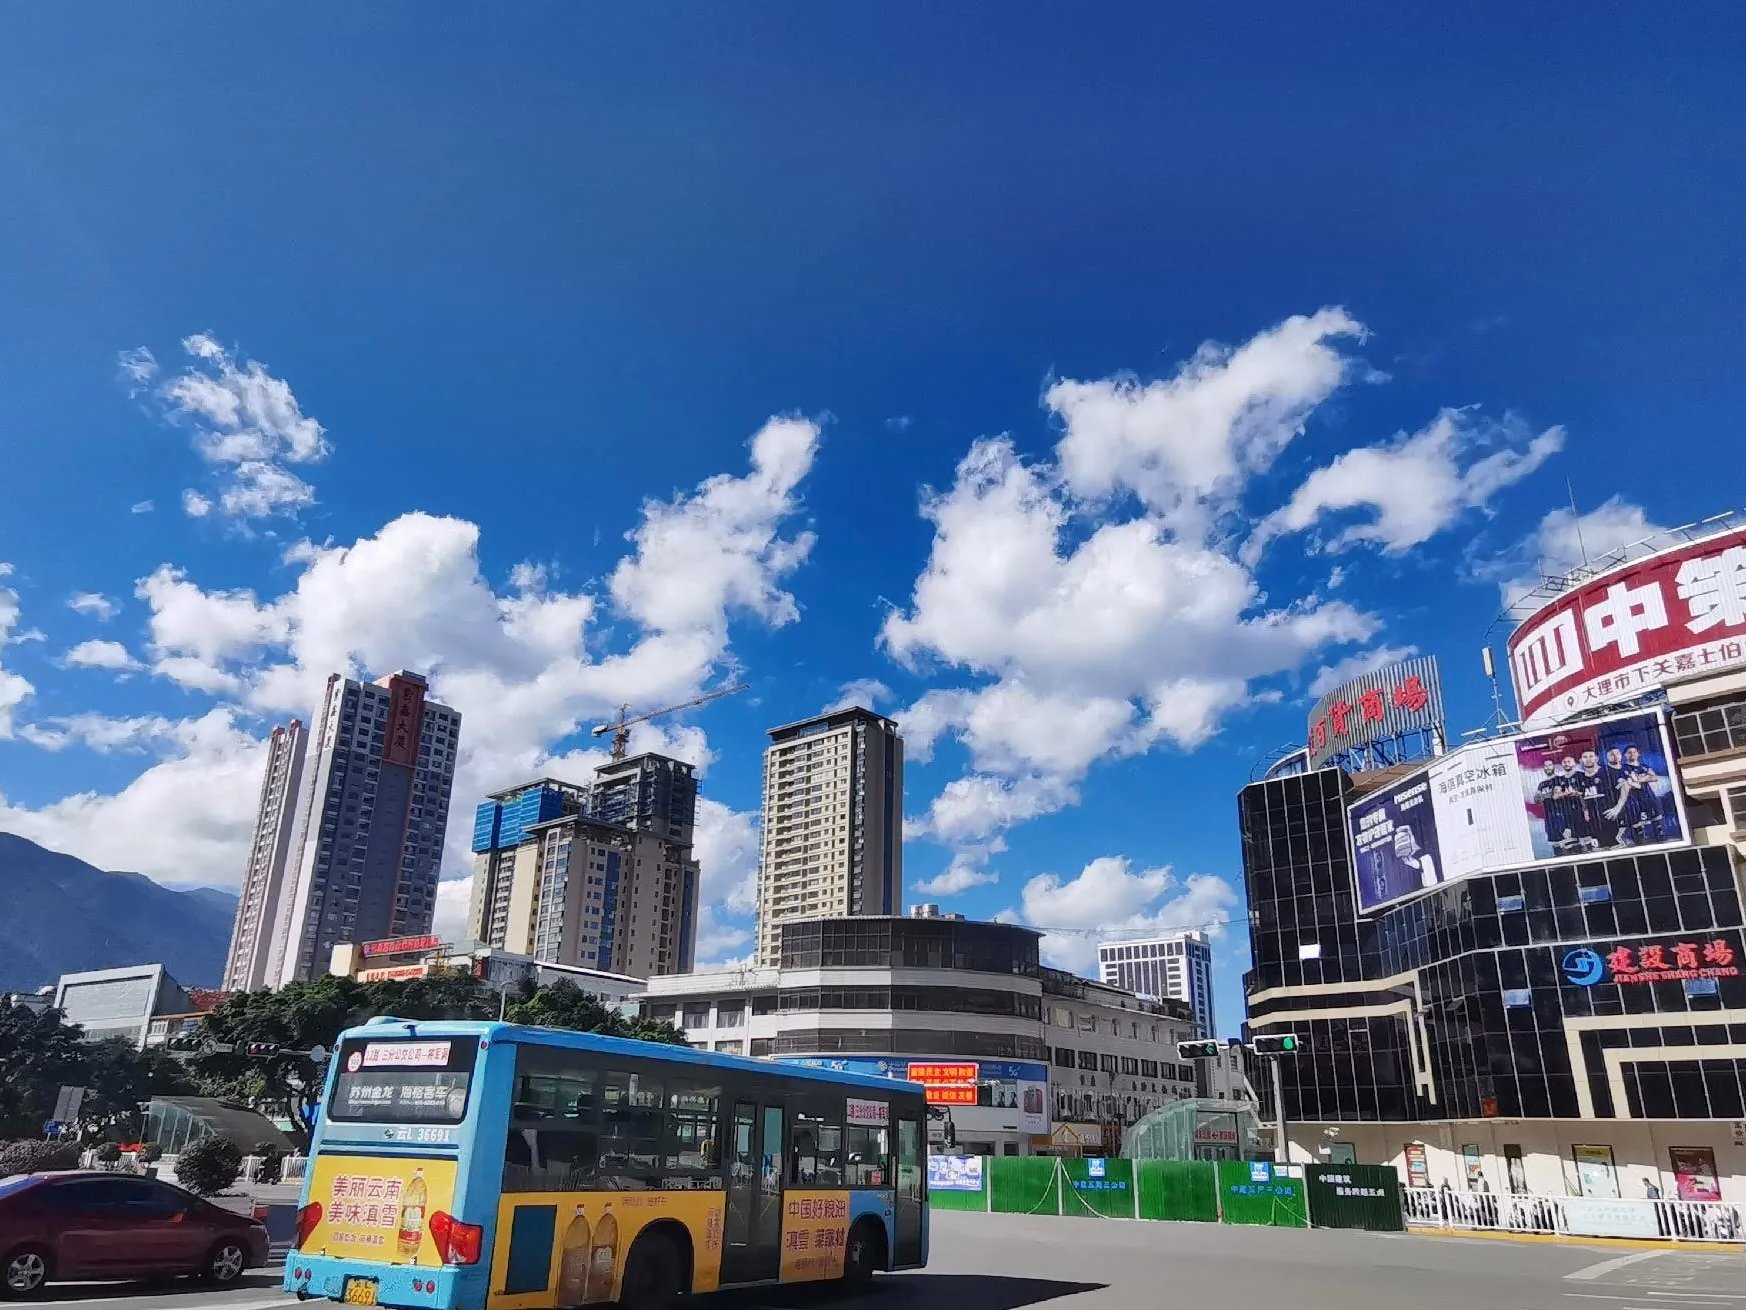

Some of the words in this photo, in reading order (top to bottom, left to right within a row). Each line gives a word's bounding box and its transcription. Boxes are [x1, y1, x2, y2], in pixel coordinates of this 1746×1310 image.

[1583, 640, 1746, 703] 大理市下关嘉士伯
[1439, 763, 1507, 793] 海信真空冰箱
[1606, 937, 1735, 974] 建設商場
[1613, 973, 1660, 984] JIANSHE
[1661, 969, 1698, 980] SHANG
[1699, 966, 1739, 977] CHANG
[349, 1085, 394, 1100] 苏州金龙
[332, 1175, 402, 1200] 美丽云南
[328, 1201, 397, 1227] 美味滇雪
[786, 1229, 810, 1250] 滇雪
[344, 1287, 375, 1306] 36691
